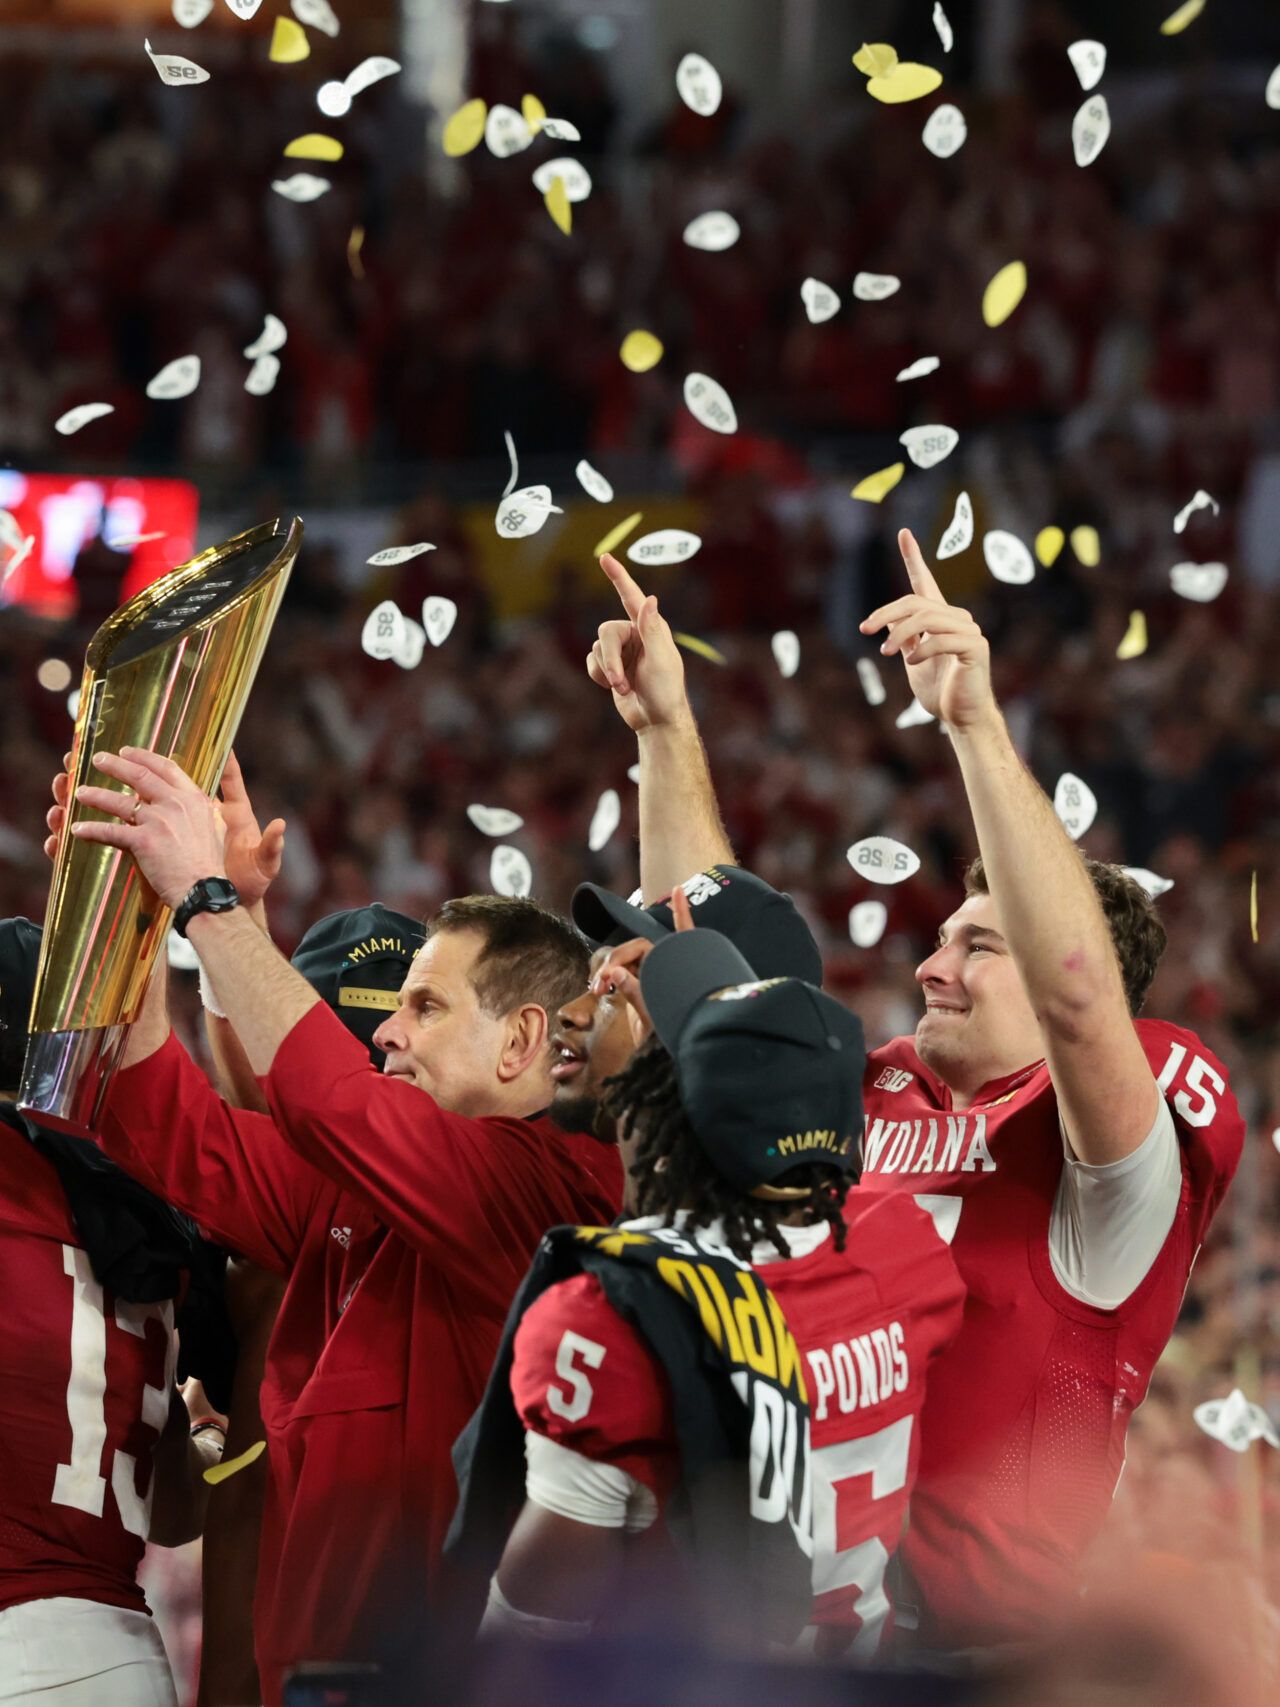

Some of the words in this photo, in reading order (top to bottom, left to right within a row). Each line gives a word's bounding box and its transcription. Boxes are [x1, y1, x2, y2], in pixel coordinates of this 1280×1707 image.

[1156, 1041, 1226, 1128] 15
[51, 1244, 180, 1541] 13
[546, 1329, 607, 1423] 5
[806, 1321, 909, 1420] PONDS
[792, 1414, 915, 1658] 5
